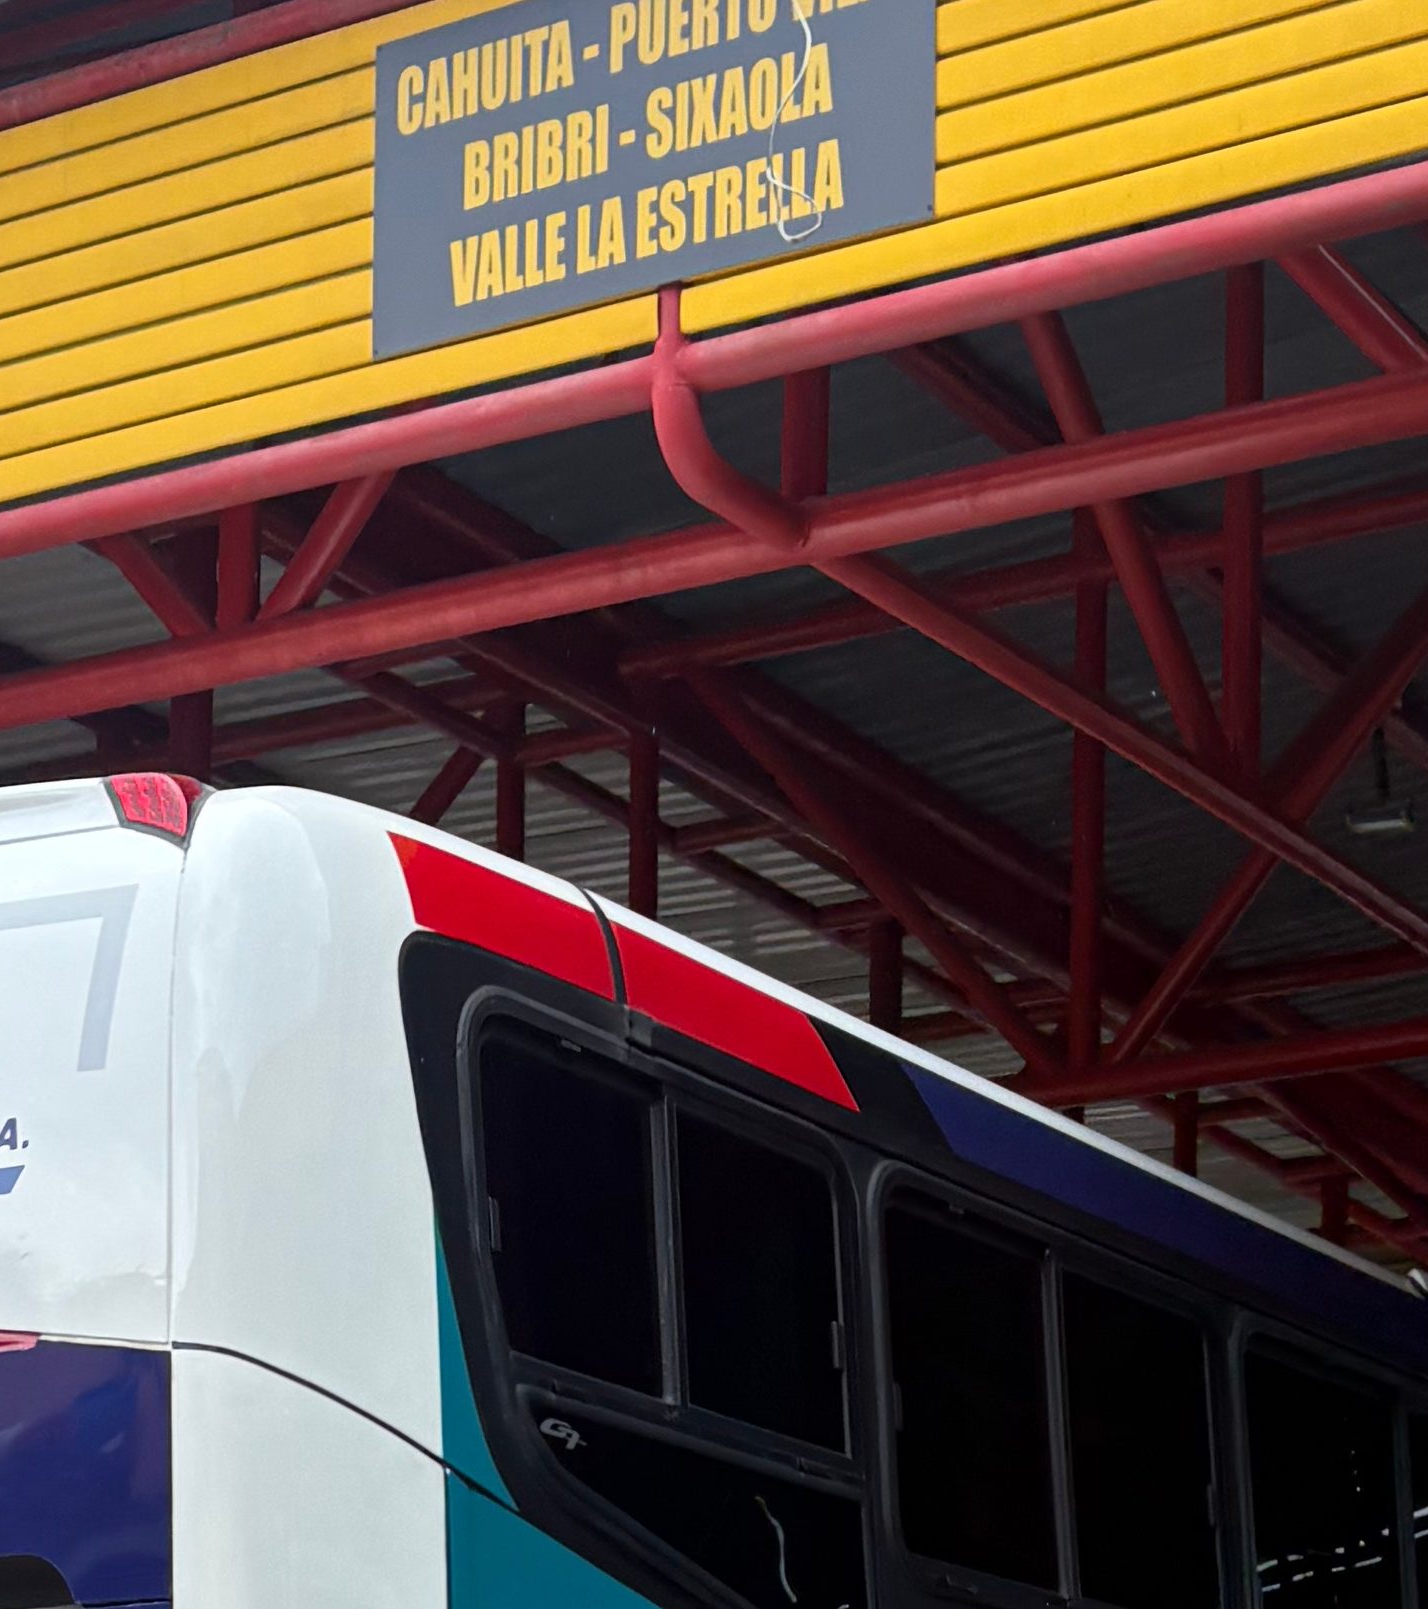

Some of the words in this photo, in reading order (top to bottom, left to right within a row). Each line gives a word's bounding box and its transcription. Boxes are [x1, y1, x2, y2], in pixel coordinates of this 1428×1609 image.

[397, 20, 574, 135] CAHUITA
[463, 105, 609, 210] BRIBRI
[645, 42, 833, 159] SIXAOLA
[450, 211, 566, 307] VALLE
[576, 196, 626, 275] LA
[636, 138, 844, 260] ESTRELLA
